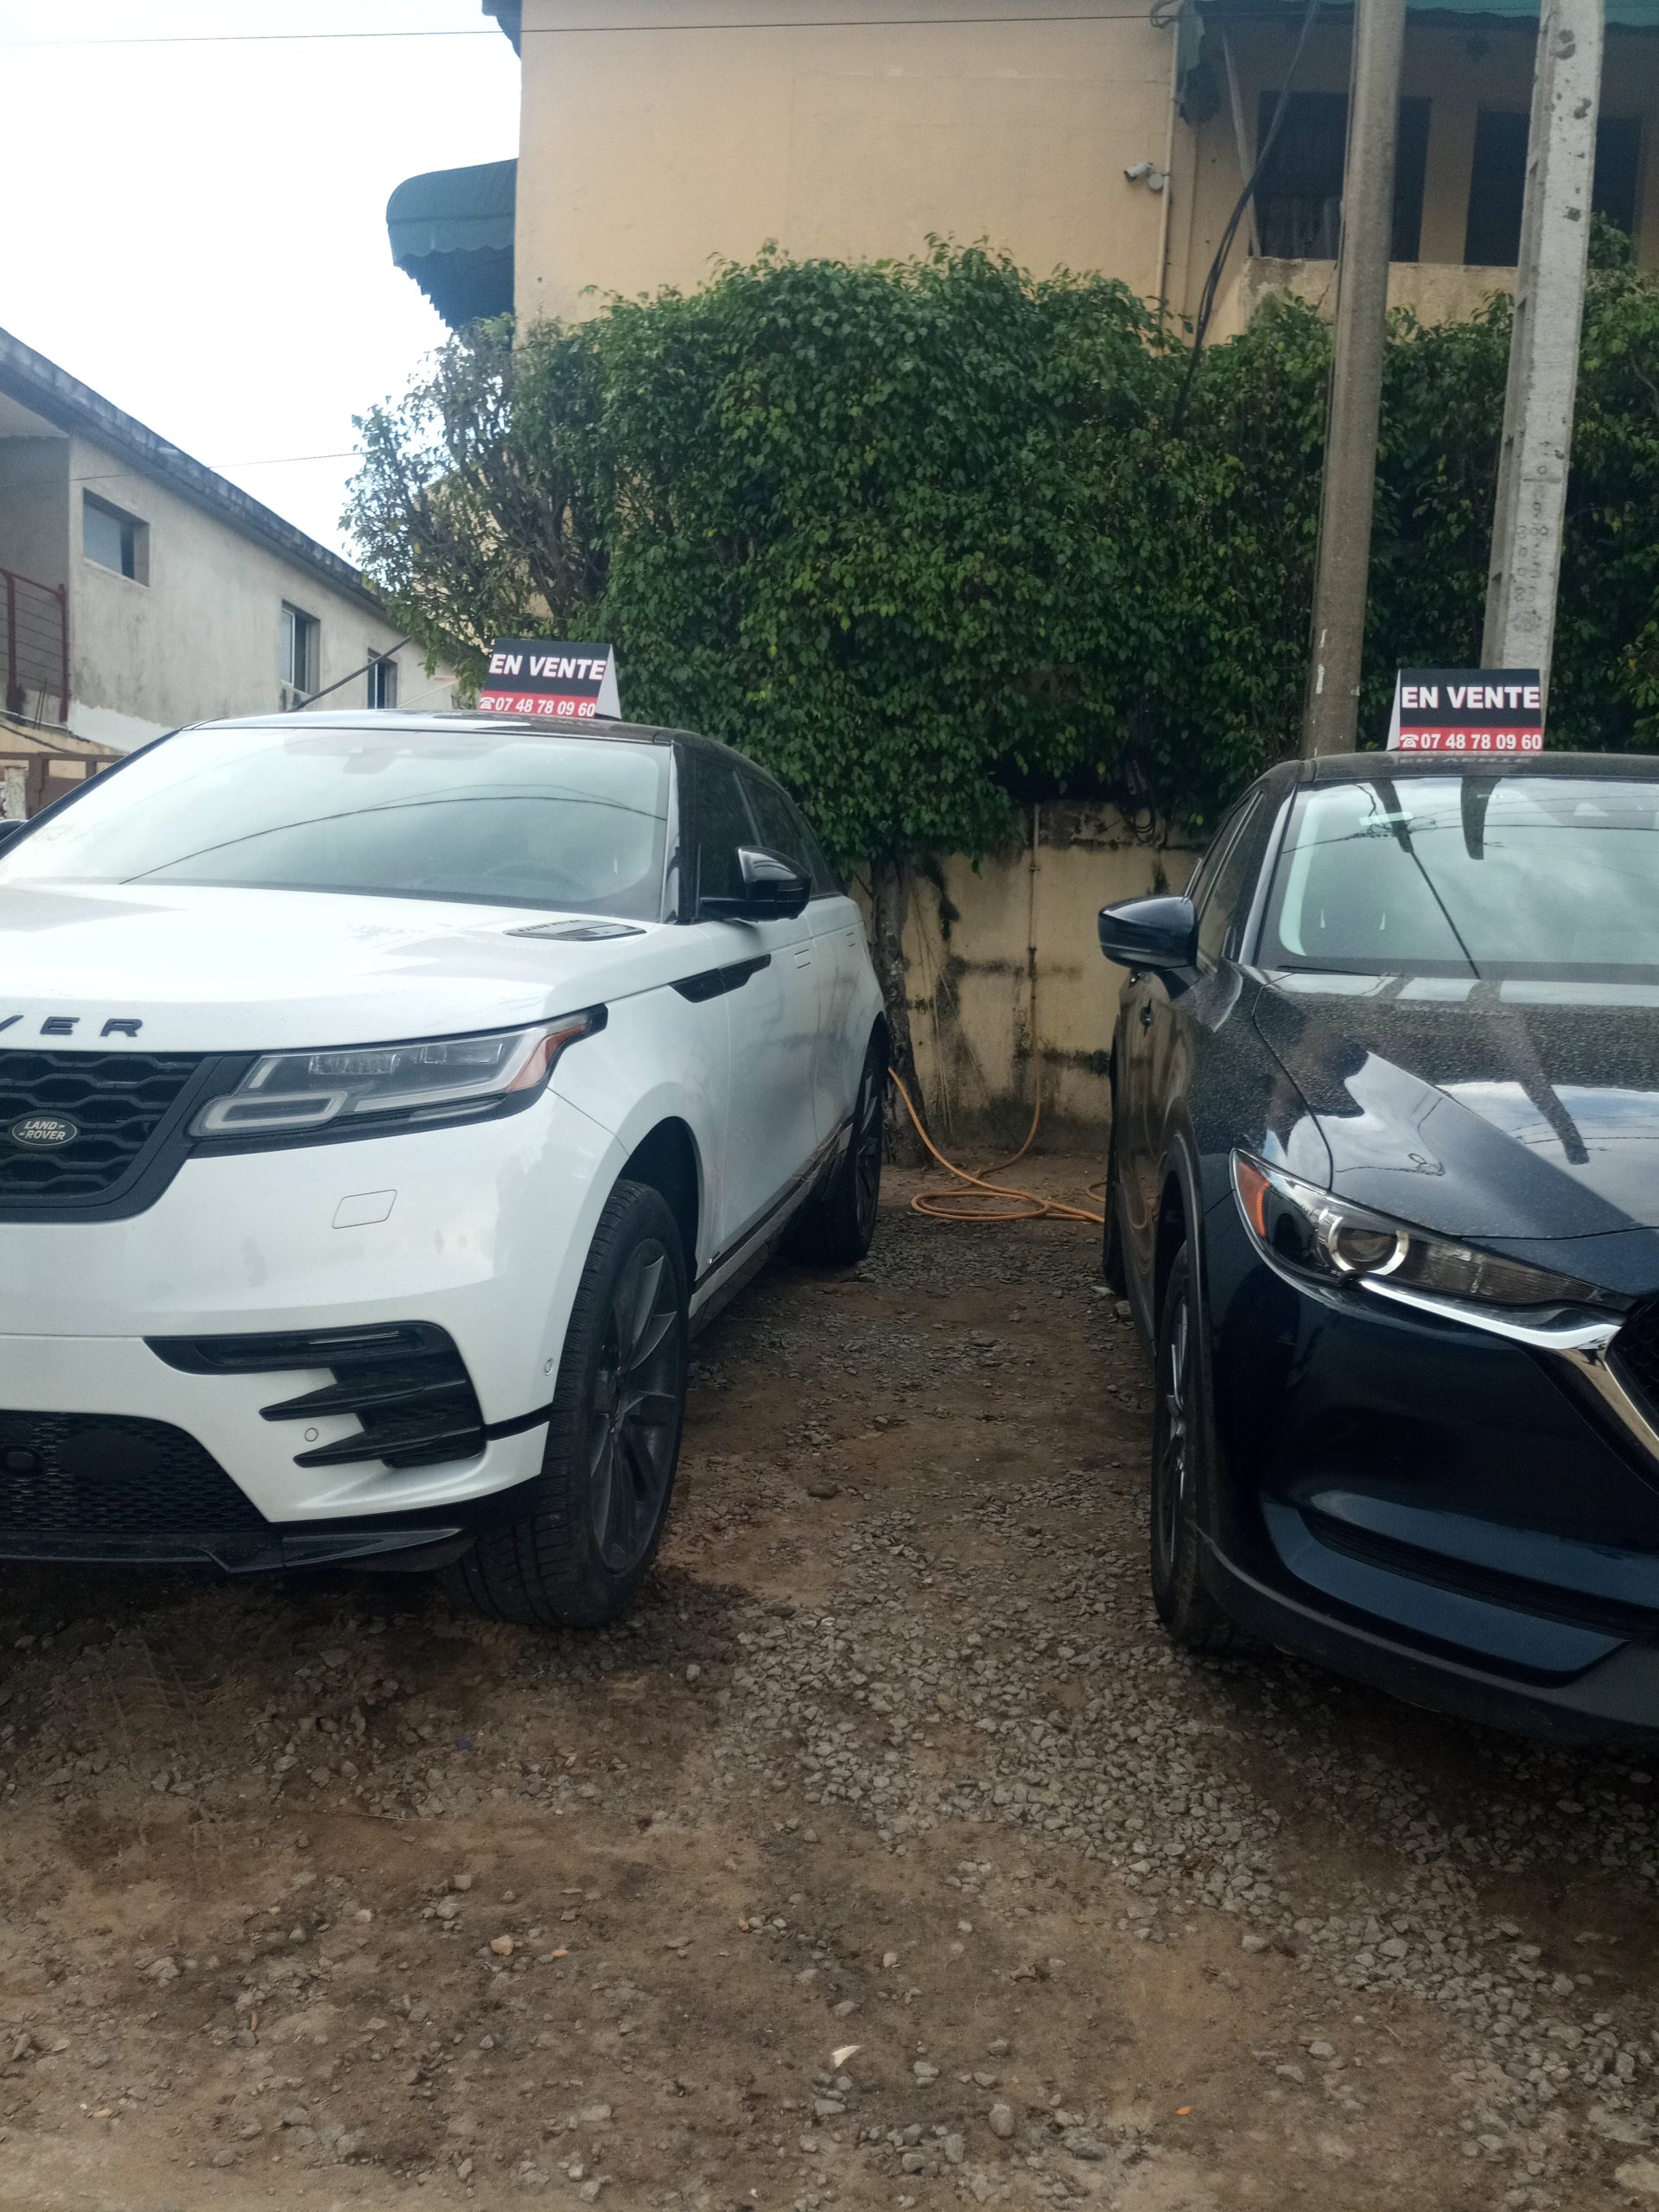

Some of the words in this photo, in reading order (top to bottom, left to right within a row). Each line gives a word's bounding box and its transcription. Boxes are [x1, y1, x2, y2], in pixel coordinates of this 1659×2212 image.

[488, 654, 523, 675] EN
[529, 656, 606, 680] VENTE
[495, 697, 513, 711] 07
[515, 698, 533, 713] 48
[537, 700, 554, 714] 78
[557, 701, 575, 715] 09
[578, 702, 596, 717] 60
[1402, 686, 1439, 709] EN
[1446, 686, 1541, 709] VENTE
[1421, 734, 1440, 748] 07
[1446, 734, 1465, 749] 48
[1471, 734, 1491, 749] 78
[1496, 734, 1516, 749] 09
[1522, 734, 1542, 750] 60
